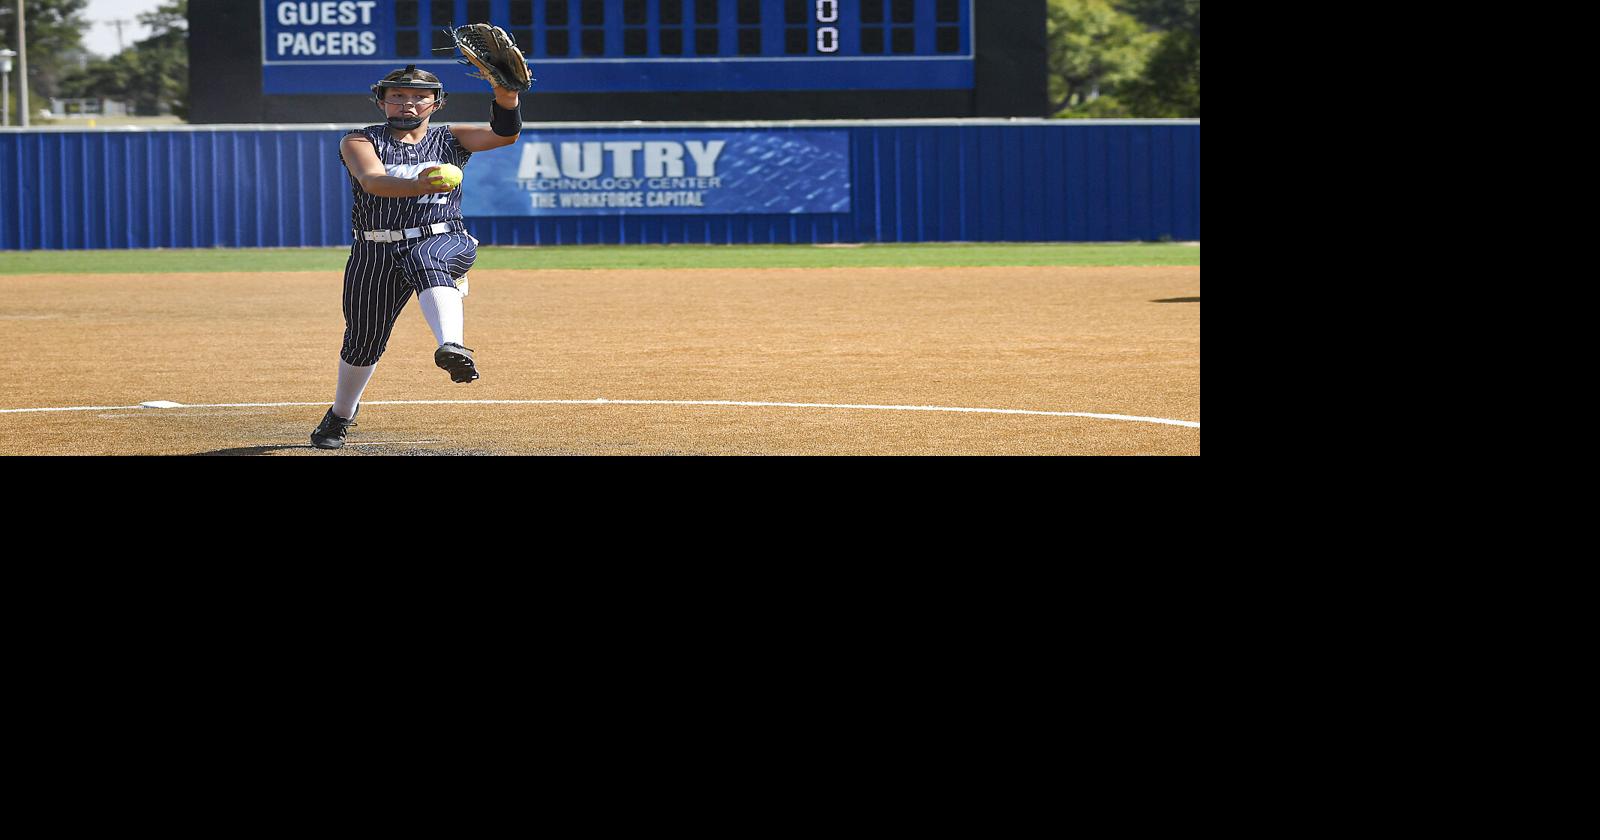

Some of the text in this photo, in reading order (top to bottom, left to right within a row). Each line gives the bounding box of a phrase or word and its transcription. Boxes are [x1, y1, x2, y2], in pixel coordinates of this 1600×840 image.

[277, 1, 376, 25] GUEST
[277, 31, 376, 55] PACERS
[816, 27, 838, 52] 0
[517, 139, 726, 179] AUTRY
[517, 176, 722, 191] TECHNOLOGY CENTER
[530, 190, 704, 208] THE WORKFORCE CAPITAL
